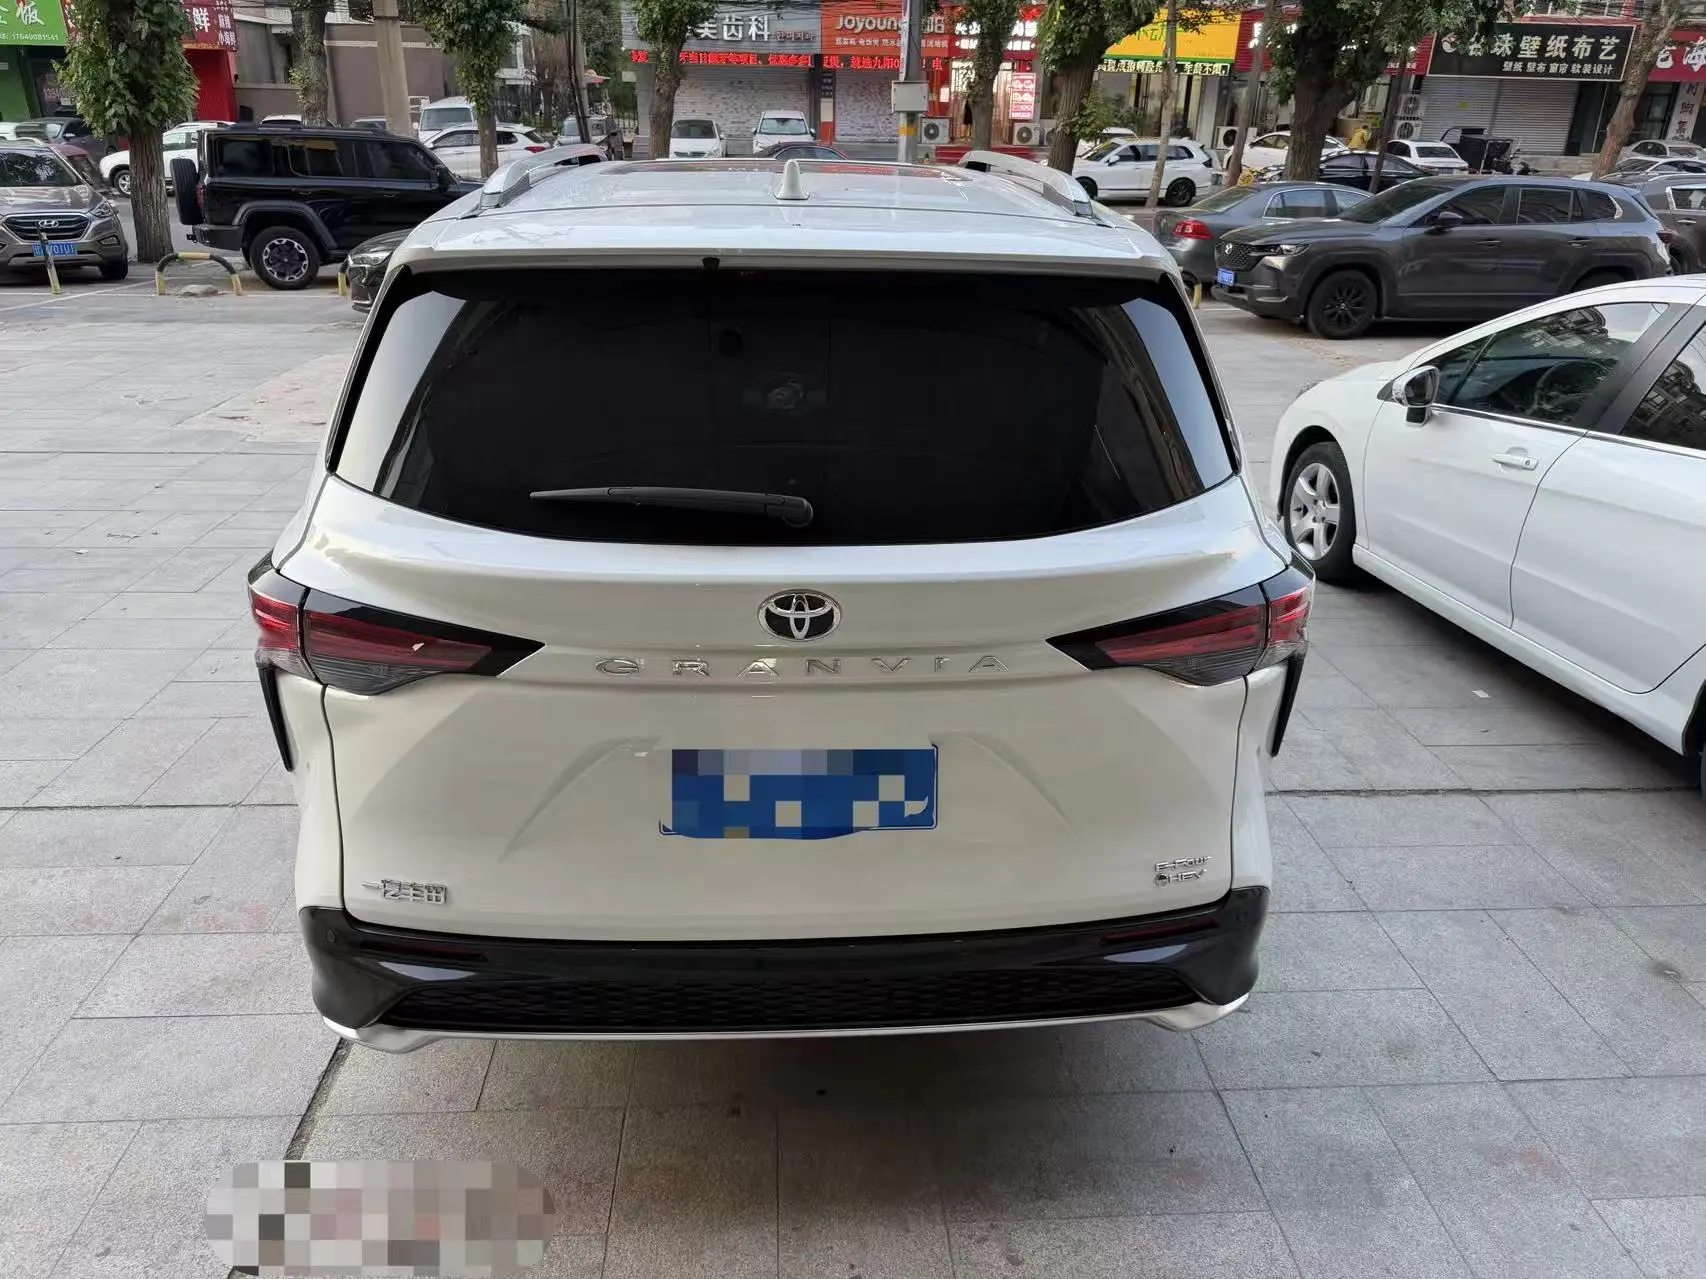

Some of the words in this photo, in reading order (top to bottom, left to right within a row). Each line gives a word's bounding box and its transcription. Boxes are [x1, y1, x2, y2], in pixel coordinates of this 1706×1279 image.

[1502, 61, 1523, 73] 壁纸
[1526, 61, 1547, 73] 壁布
[1549, 62, 1569, 74] 窗帘
[1570, 63, 1613, 75] 软装设计
[594, 655, 1009, 679] GRANVIA
